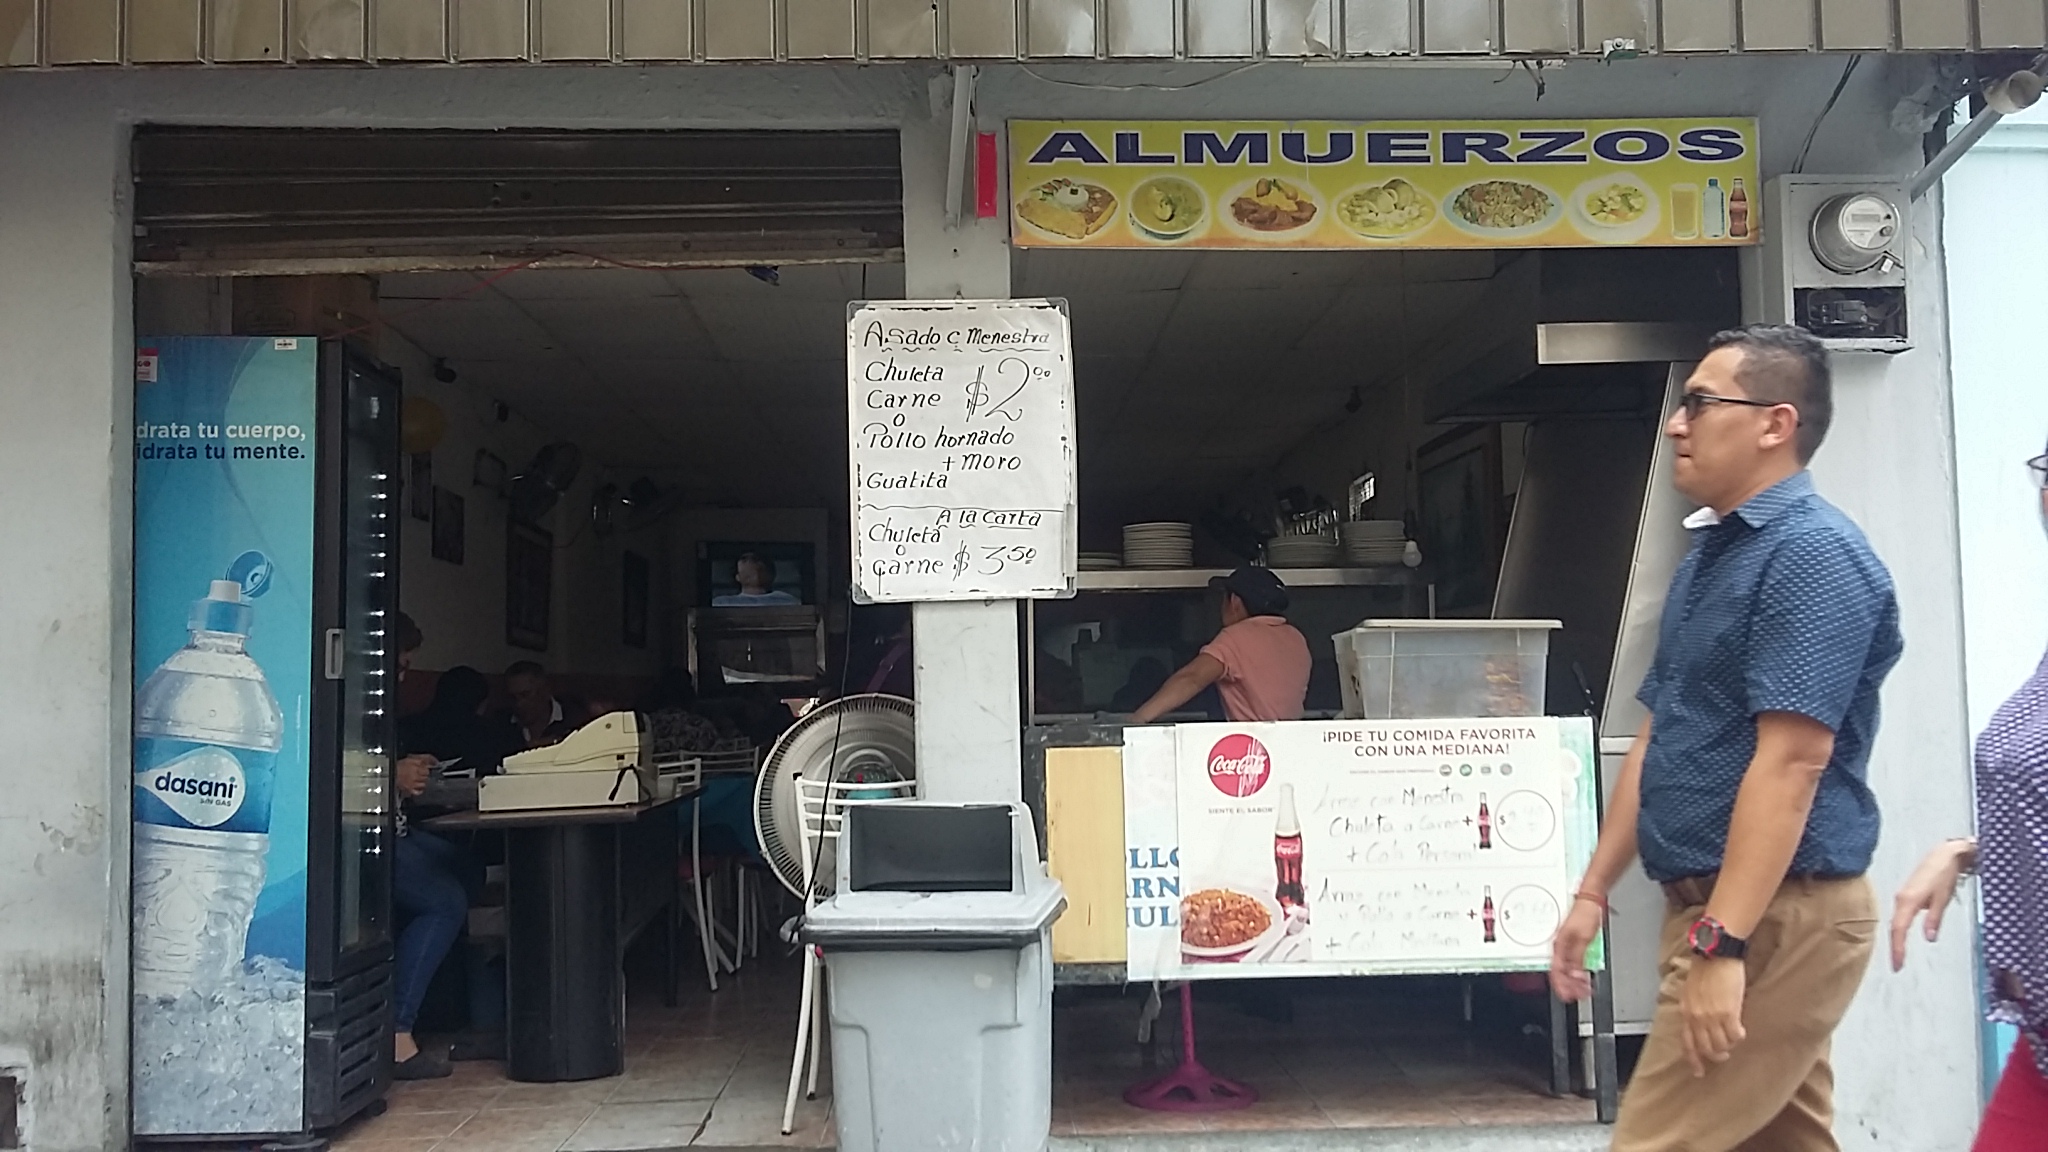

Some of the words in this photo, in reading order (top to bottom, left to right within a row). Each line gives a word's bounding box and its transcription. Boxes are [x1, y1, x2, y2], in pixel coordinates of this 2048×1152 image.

[1028, 129, 1745, 164] ALMUERZOS
[865, 356, 944, 383] Chuleta
[867, 388, 942, 409] Carne
[197, 422, 219, 438] tu
[226, 423, 306, 441] cuerpo,
[863, 422, 926, 449] Pollo
[934, 425, 1015, 448] hornado
[205, 443, 225, 459] tu
[233, 443, 306, 460] mente.
[866, 470, 949, 490] Guatita
[959, 509, 977, 525] la
[868, 517, 941, 544] Chuleta
[1323, 731, 1363, 742] ¡PIDE
[1367, 730, 1388, 742] TU
[1393, 729, 1455, 741] COMIDA
[1460, 728, 1536, 740] FAVORITA
[1354, 745, 1388, 757] CON
[1393, 745, 1427, 756] UNA
[1432, 743, 1510, 756] MEDIANA!
[155, 771, 236, 799] dasani
